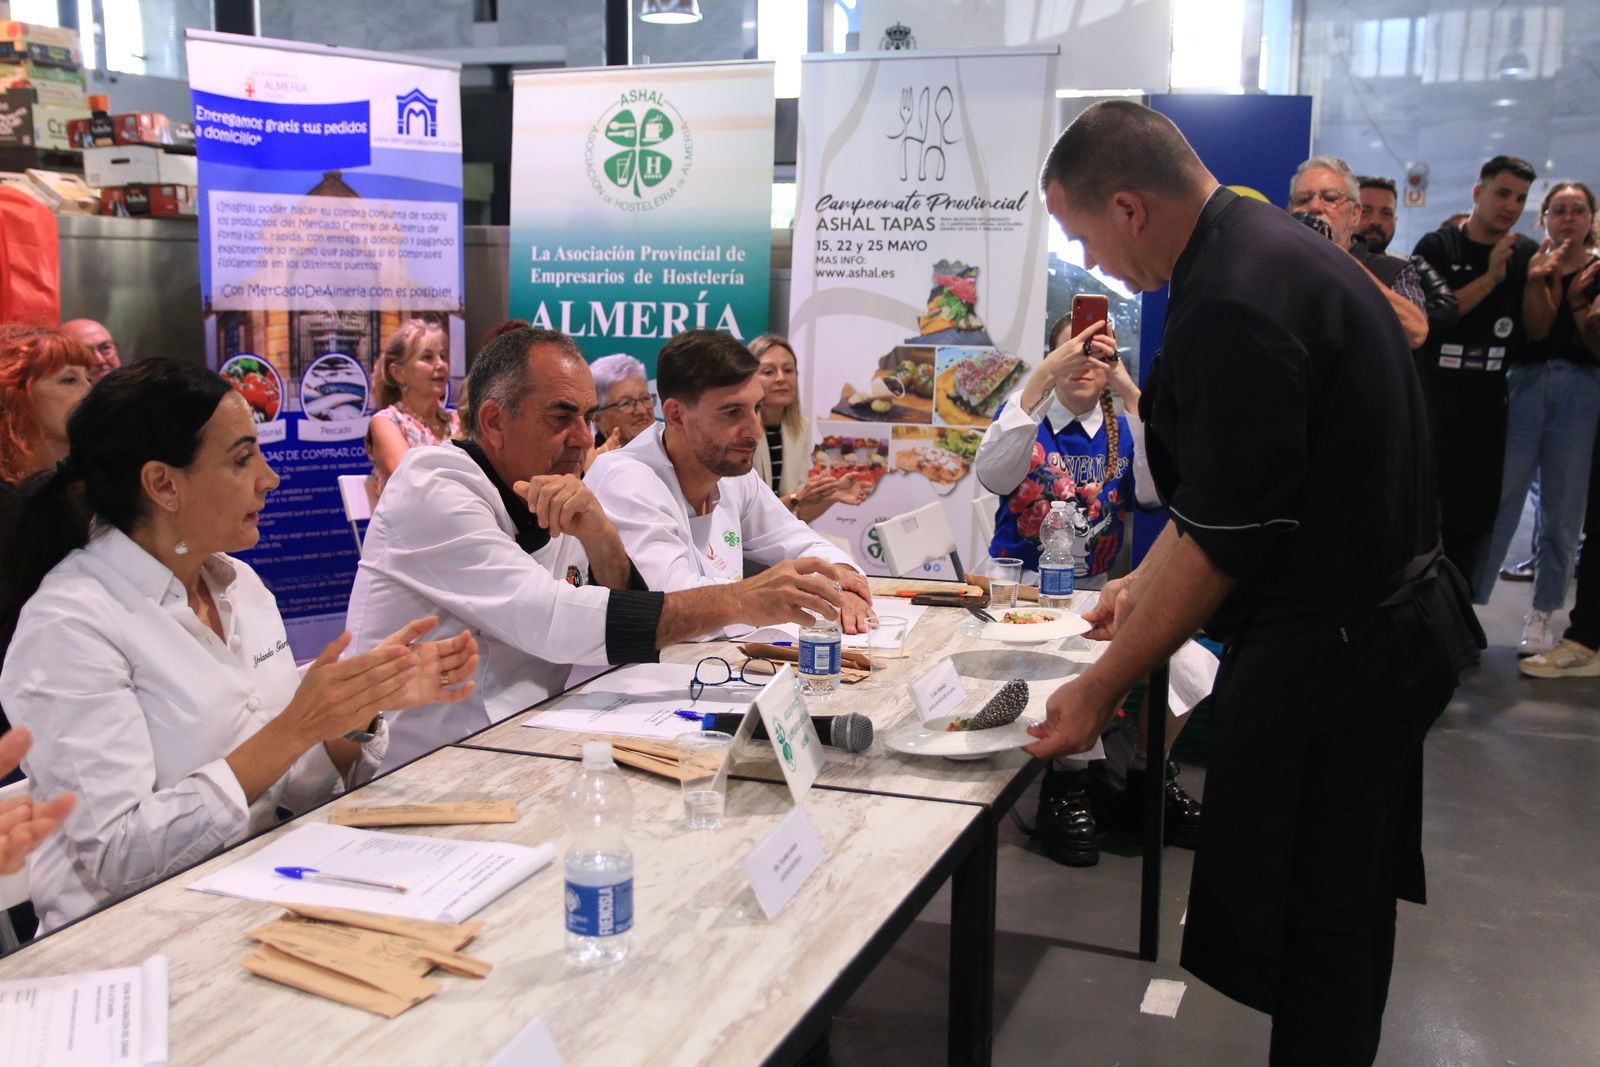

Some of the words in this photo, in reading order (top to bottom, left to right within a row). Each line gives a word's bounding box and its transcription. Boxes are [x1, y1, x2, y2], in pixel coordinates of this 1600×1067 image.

[620, 89, 664, 107] ASHAL
[196, 104, 263, 130] Entregamos
[265, 119, 300, 133] gratis
[302, 121, 322, 134] tus
[324, 120, 368, 136] pedidos
[195, 125, 202, 137] a
[815, 190, 921, 215] Campeonato
[926, 190, 1029, 212] Provincial
[258, 204, 287, 214] poder
[291, 205, 317, 215] hacer
[333, 208, 366, 217] compra
[232, 217, 277, 227] productos
[299, 219, 341, 230] Mercado
[343, 221, 377, 231] Central
[816, 217, 875, 231] ASHAL
[881, 217, 936, 231] TAPAS
[532, 246, 550, 261] La
[555, 245, 635, 262] Asociación
[640, 245, 720, 262] Provincial
[726, 245, 746, 262] de
[817, 240, 832, 252] 15,
[837, 240, 852, 251] 22
[856, 242, 863, 254] y
[868, 240, 883, 251] 25
[888, 240, 927, 251] MAYO
[816, 256, 837, 265] MAS
[840, 256, 866, 265] INFO:
[531, 268, 625, 287] Empresarios
[634, 268, 652, 283] de
[663, 268, 745, 285] Hostelería
[816, 268, 895, 279] www.ashal.es
[396, 287, 407, 298] es
[409, 286, 452, 299] posible!
[532, 290, 745, 340] ALMERÍA
[320, 425, 352, 435] Pescado
[286, 449, 300, 460] DE
[301, 447, 349, 459] COMPRAR
[350, 446, 367, 457] CO
[598, 886, 614, 935] FUENCISLA
